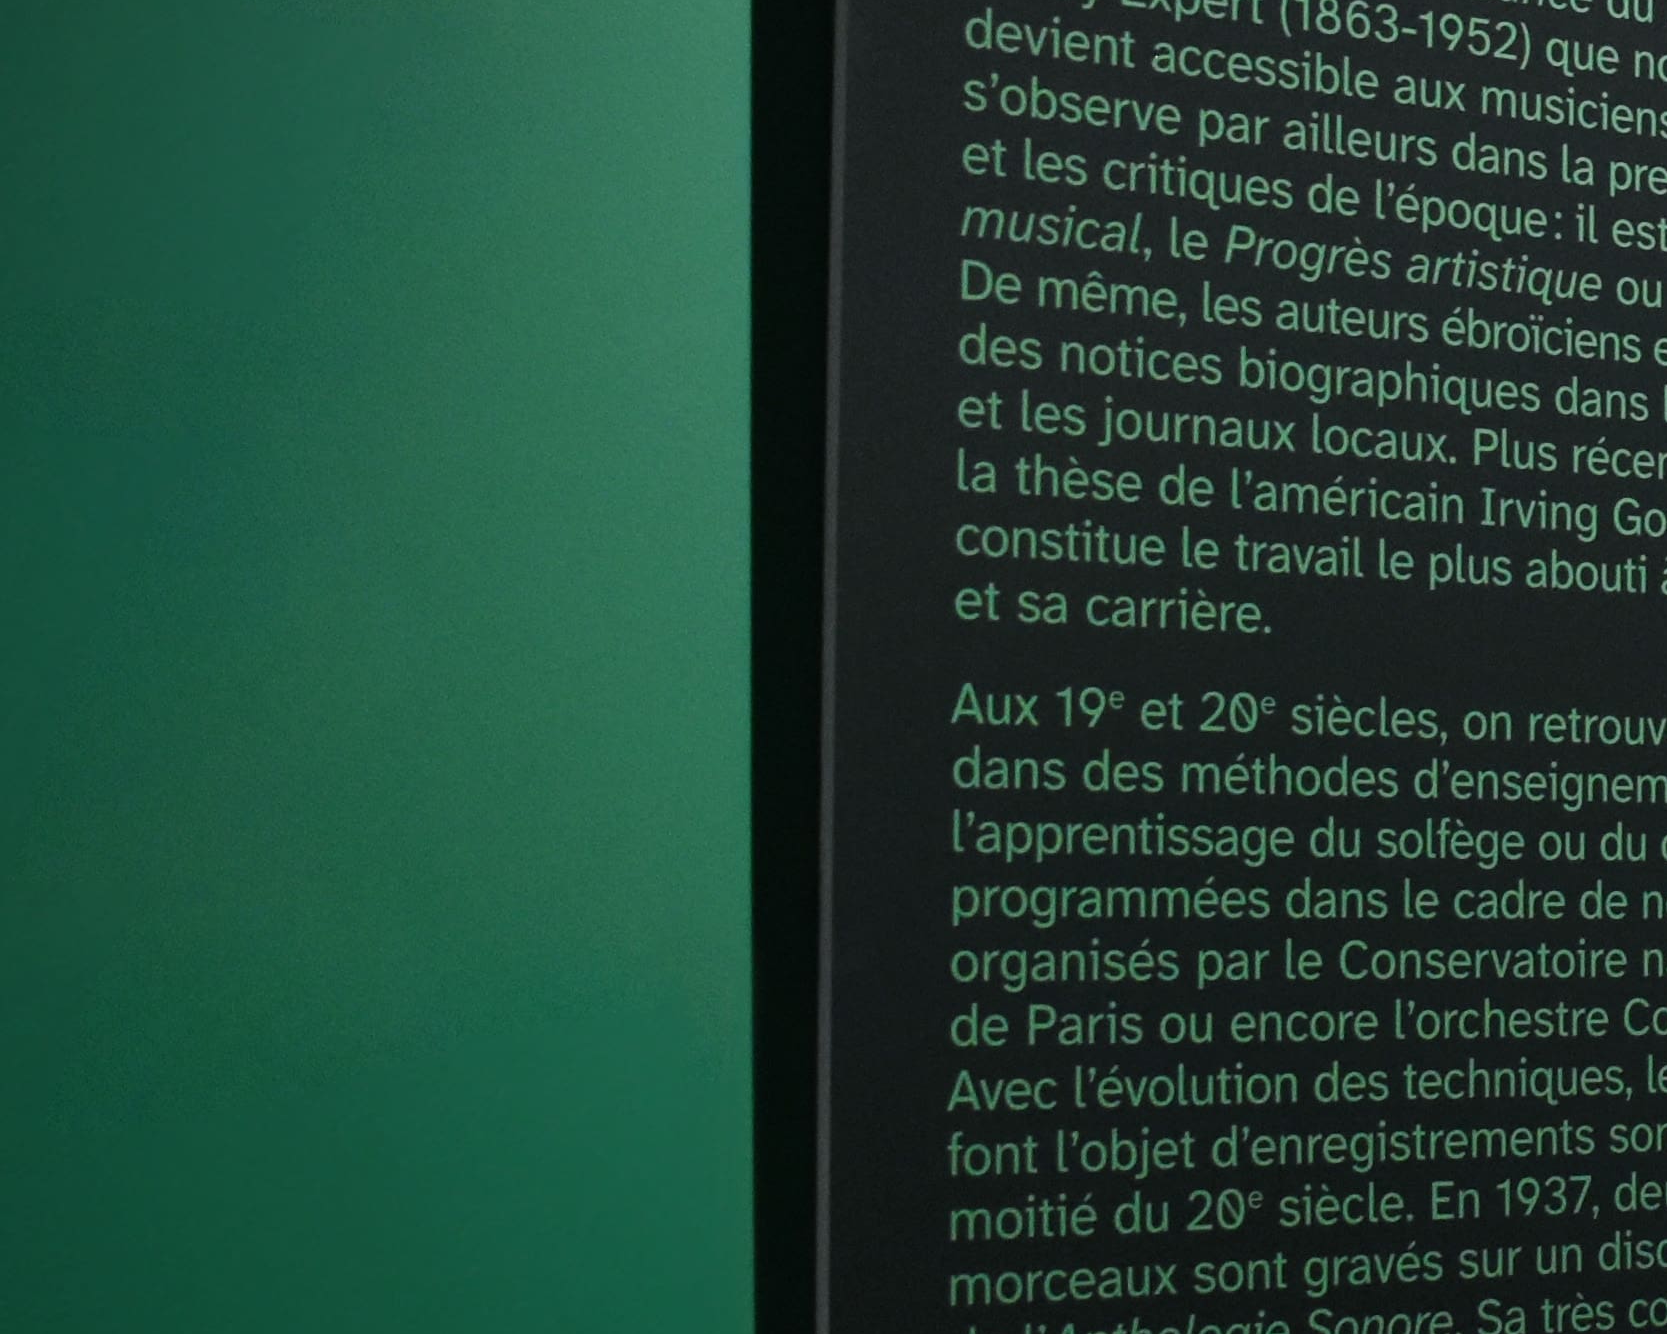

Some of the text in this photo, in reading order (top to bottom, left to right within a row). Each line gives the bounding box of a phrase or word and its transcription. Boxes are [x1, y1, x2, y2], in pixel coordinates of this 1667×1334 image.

[964, 5, 1136, 70] devient
[1150, 41, 1380, 101] accessible
[1392, 73, 1467, 113] aux
[1544, 36, 1621, 79] que
[962, 71, 1183, 137] s'observe
[1197, 107, 1272, 149] par
[1281, 110, 1439, 168] ailleurs
[1450, 130, 1549, 182] dans
[1560, 142, 1595, 187] la
[958, 321, 1044, 371] des
[1059, 334, 1224, 386] notices
[1238, 344, 1542, 417] biographiques
[1553, 374, 1650, 423] dans
[956, 446, 998, 494] la
[1013, 452, 1144, 504] thèse
[1157, 462, 1216, 509] de
[1230, 465, 1465, 525] l'américain
[1479, 486, 1599, 544] Irving
[953, 581, 1273, 635] et sa carrière.
[951, 743, 1068, 792] dans
[1081, 747, 1165, 794] des
[1180, 751, 1400, 799] méthodes
[949, 1001, 1010, 1049] de
[1027, 999, 1145, 1047] Paris
[1158, 1011, 1214, 1045] ou
[1229, 1009, 1380, 1044] encore
[1393, 996, 1611, 1042] l'orchestre
[946, 1130, 1039, 1178] font
[1055, 1125, 1197, 1181] l'objet
[1210, 1118, 1597, 1175] d'enregistrements
